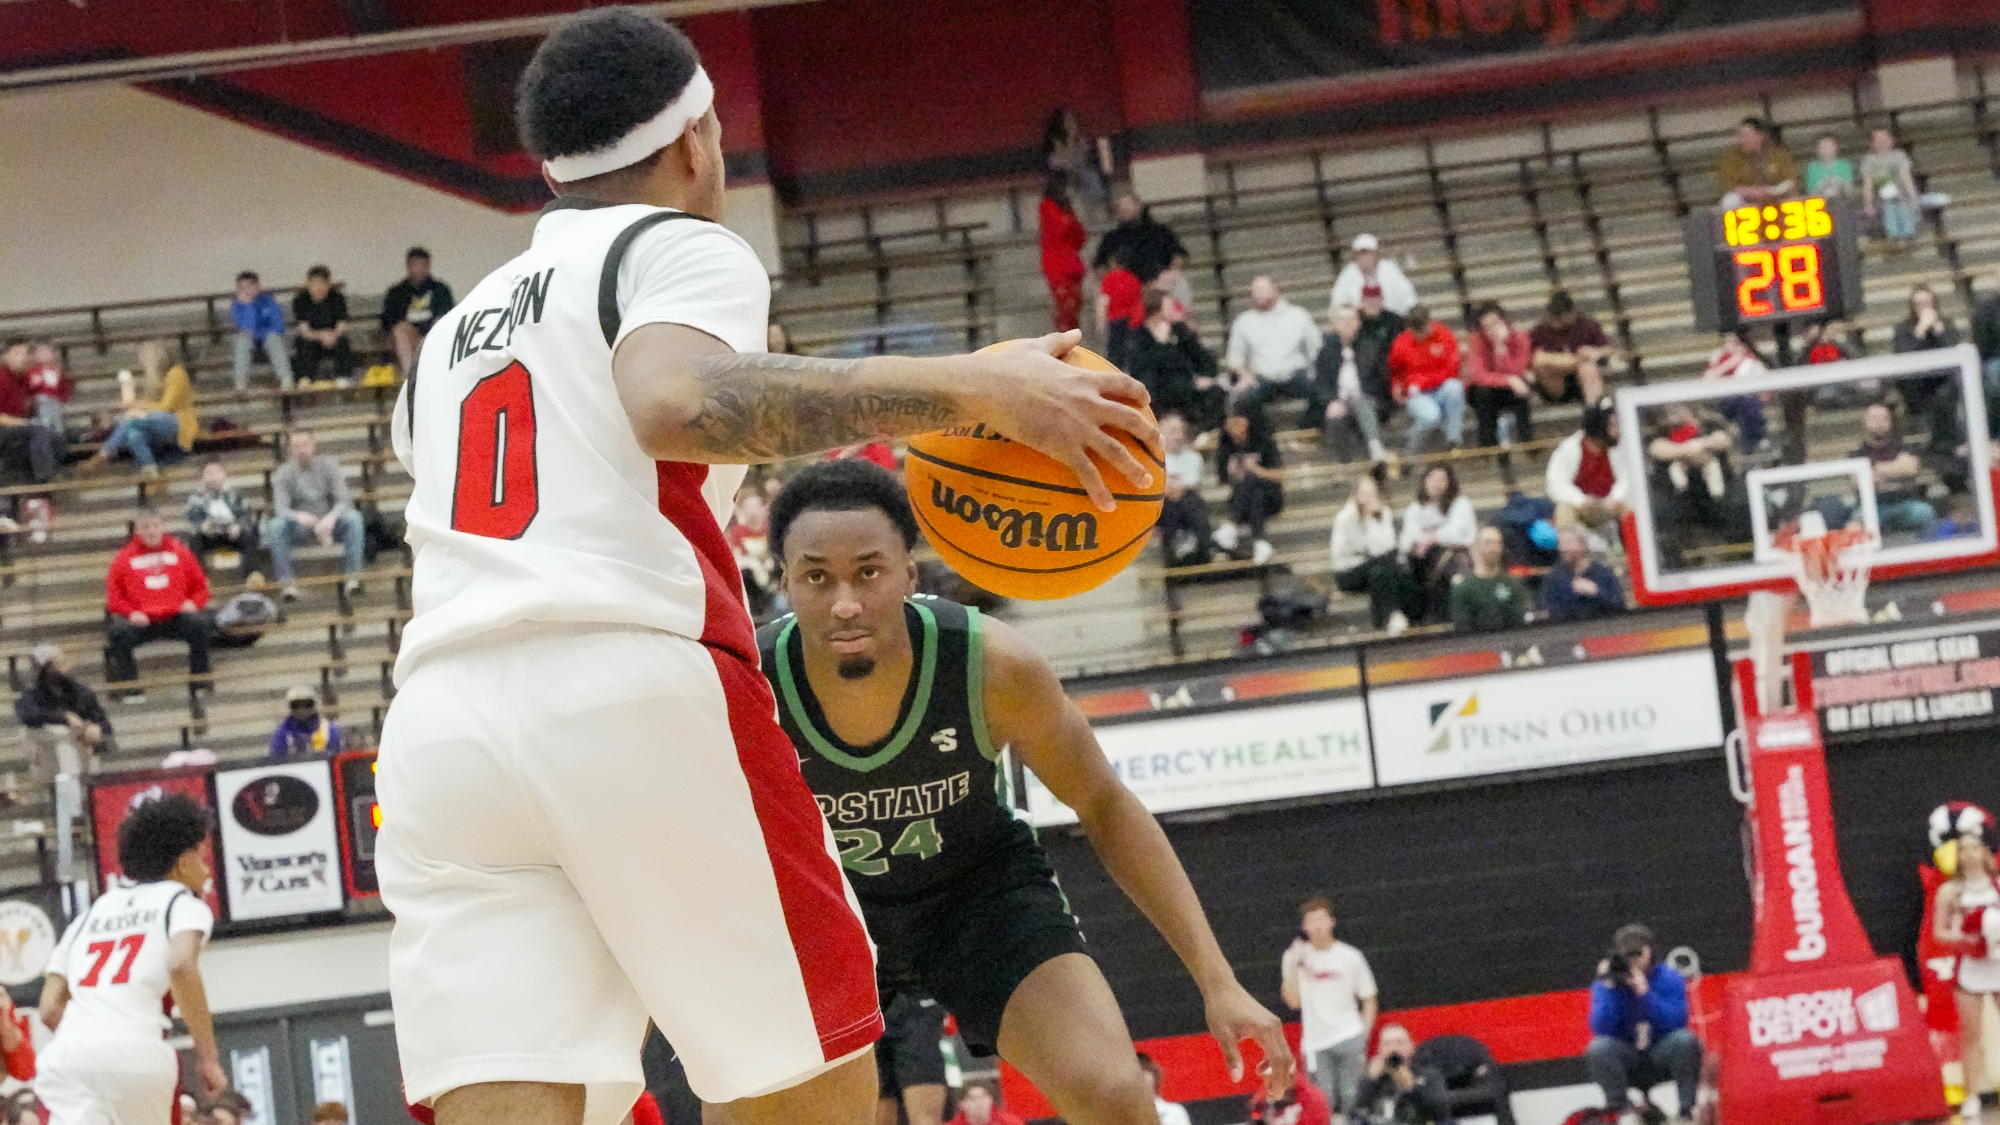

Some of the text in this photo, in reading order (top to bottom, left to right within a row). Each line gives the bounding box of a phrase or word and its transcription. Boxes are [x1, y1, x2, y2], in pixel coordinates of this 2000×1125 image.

[1723, 197, 1833, 246] 12:36
[1733, 243, 1825, 316] 28
[448, 267, 555, 371] NELON
[451, 358, 539, 541] 0
[930, 476, 1098, 552] Wilson
[1560, 703, 1658, 740] OHIO
[813, 770, 970, 823] PSTATE
[832, 817, 943, 876] 24
[79, 933, 146, 987] 77
[1746, 987, 1853, 1021] WINDOW
[1749, 1008, 1857, 1047] DEPOT
